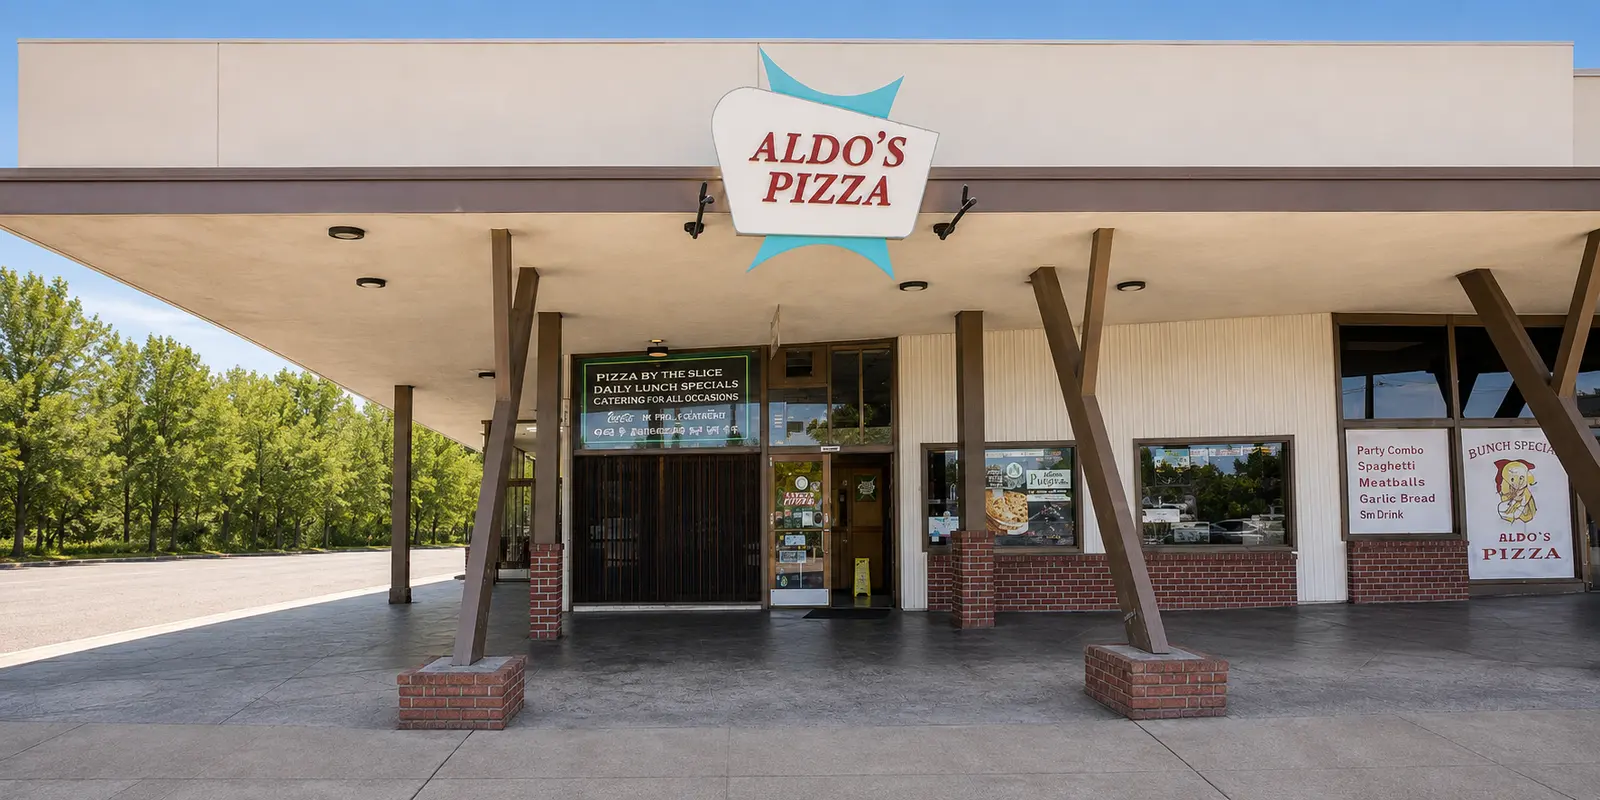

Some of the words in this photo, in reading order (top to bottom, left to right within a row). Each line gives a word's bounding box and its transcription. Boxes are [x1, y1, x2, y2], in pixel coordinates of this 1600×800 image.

[748, 130, 907, 168] ALDO'S
[762, 171, 891, 207] PIZZA
[596, 372, 638, 382] PIZZA
[641, 371, 659, 380] BY
[660, 370, 686, 379] THE
[687, 368, 723, 378] SLICE
[593, 385, 632, 394] DAILY
[635, 383, 678, 393] LUNCH
[680, 380, 739, 391] SPECIALS
[593, 396, 646, 406] CATERING
[646, 395, 665, 404] FOR
[665, 394, 684, 403] ALL
[684, 393, 739, 403] OCCASIONS
[1357, 445, 1385, 457] Party
[1387, 445, 1424, 455] Combo
[1468, 441, 1511, 460] BUNCH
[1358, 461, 1416, 472] Spaghetti
[1359, 477, 1425, 488] Meatballs
[1359, 493, 1397, 504] Garlic
[1400, 493, 1436, 503] Bread
[1360, 510, 1375, 520] Sm
[1377, 510, 1404, 519] Drink
[1482, 547, 1561, 561] PIZZA
